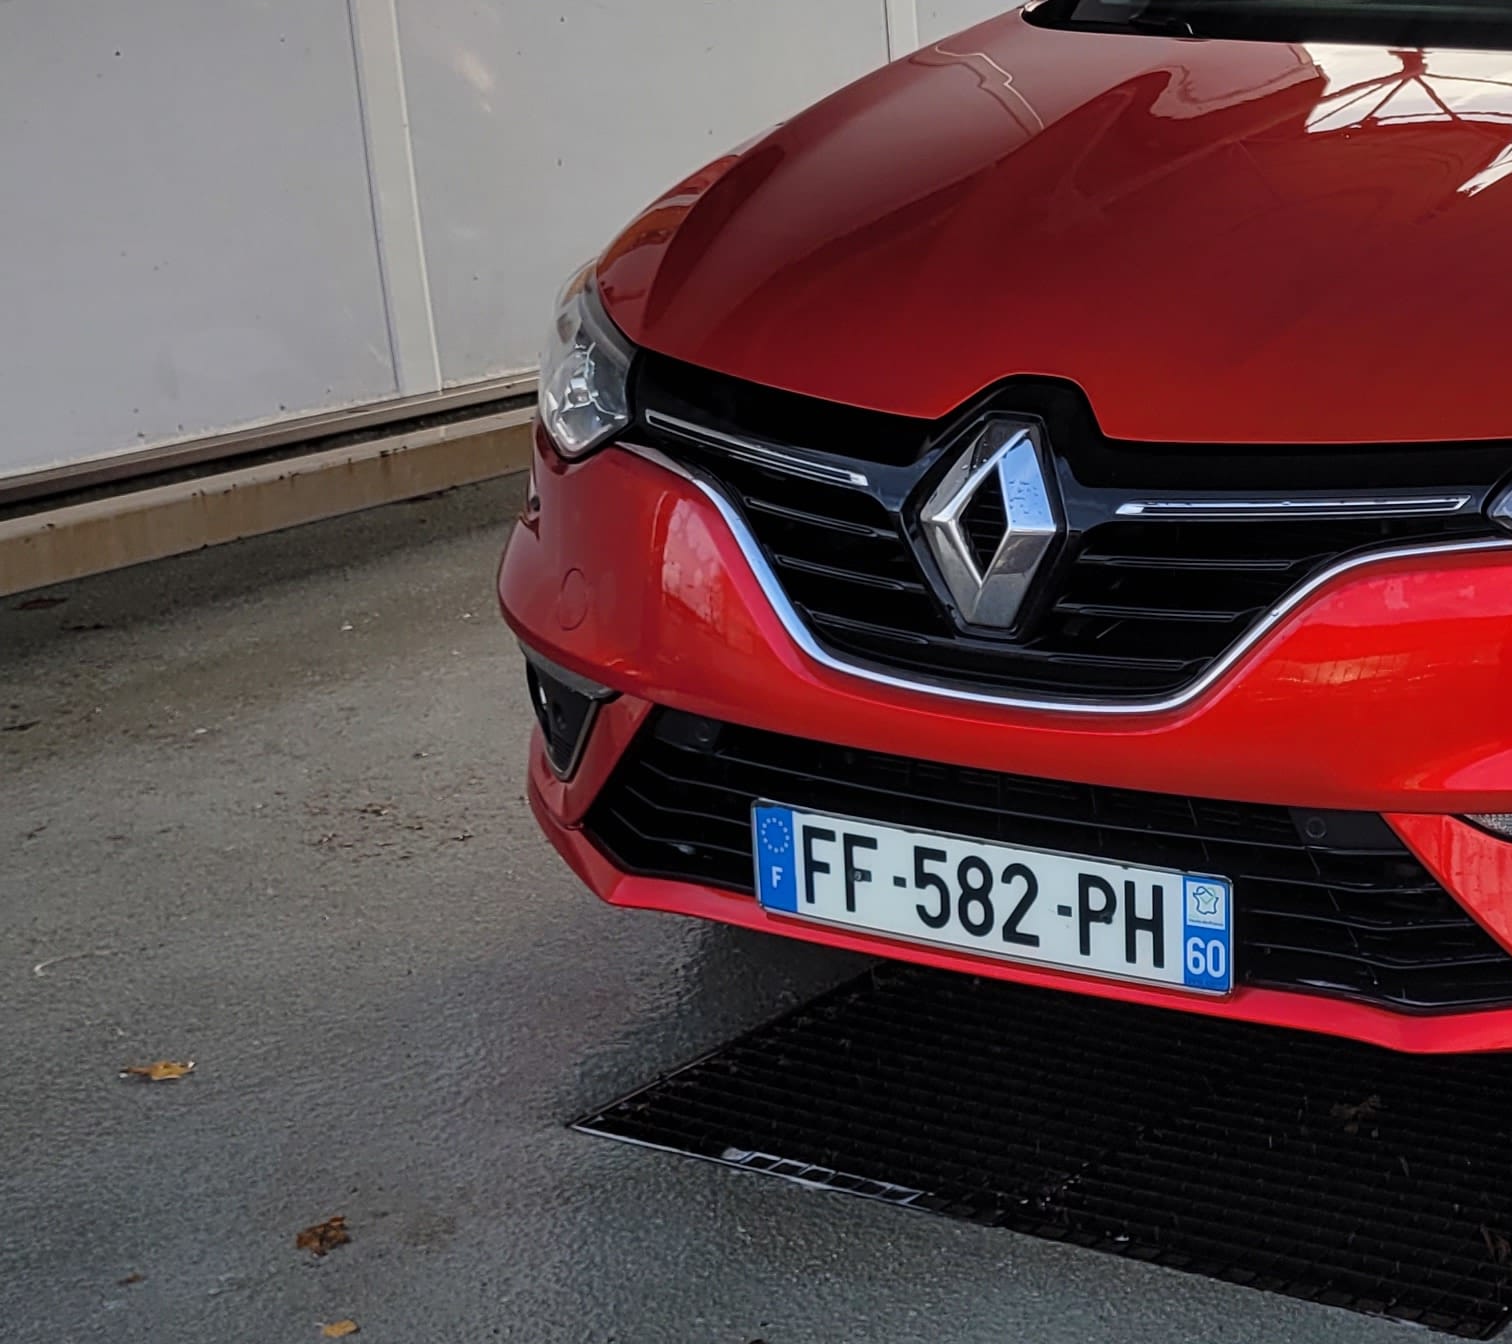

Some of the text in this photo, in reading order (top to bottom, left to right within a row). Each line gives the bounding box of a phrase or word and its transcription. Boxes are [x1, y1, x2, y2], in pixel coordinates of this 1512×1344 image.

[771, 866, 783, 888] F
[802, 825, 1165, 968] FF-582-PH
[1186, 936, 1226, 978] 60
